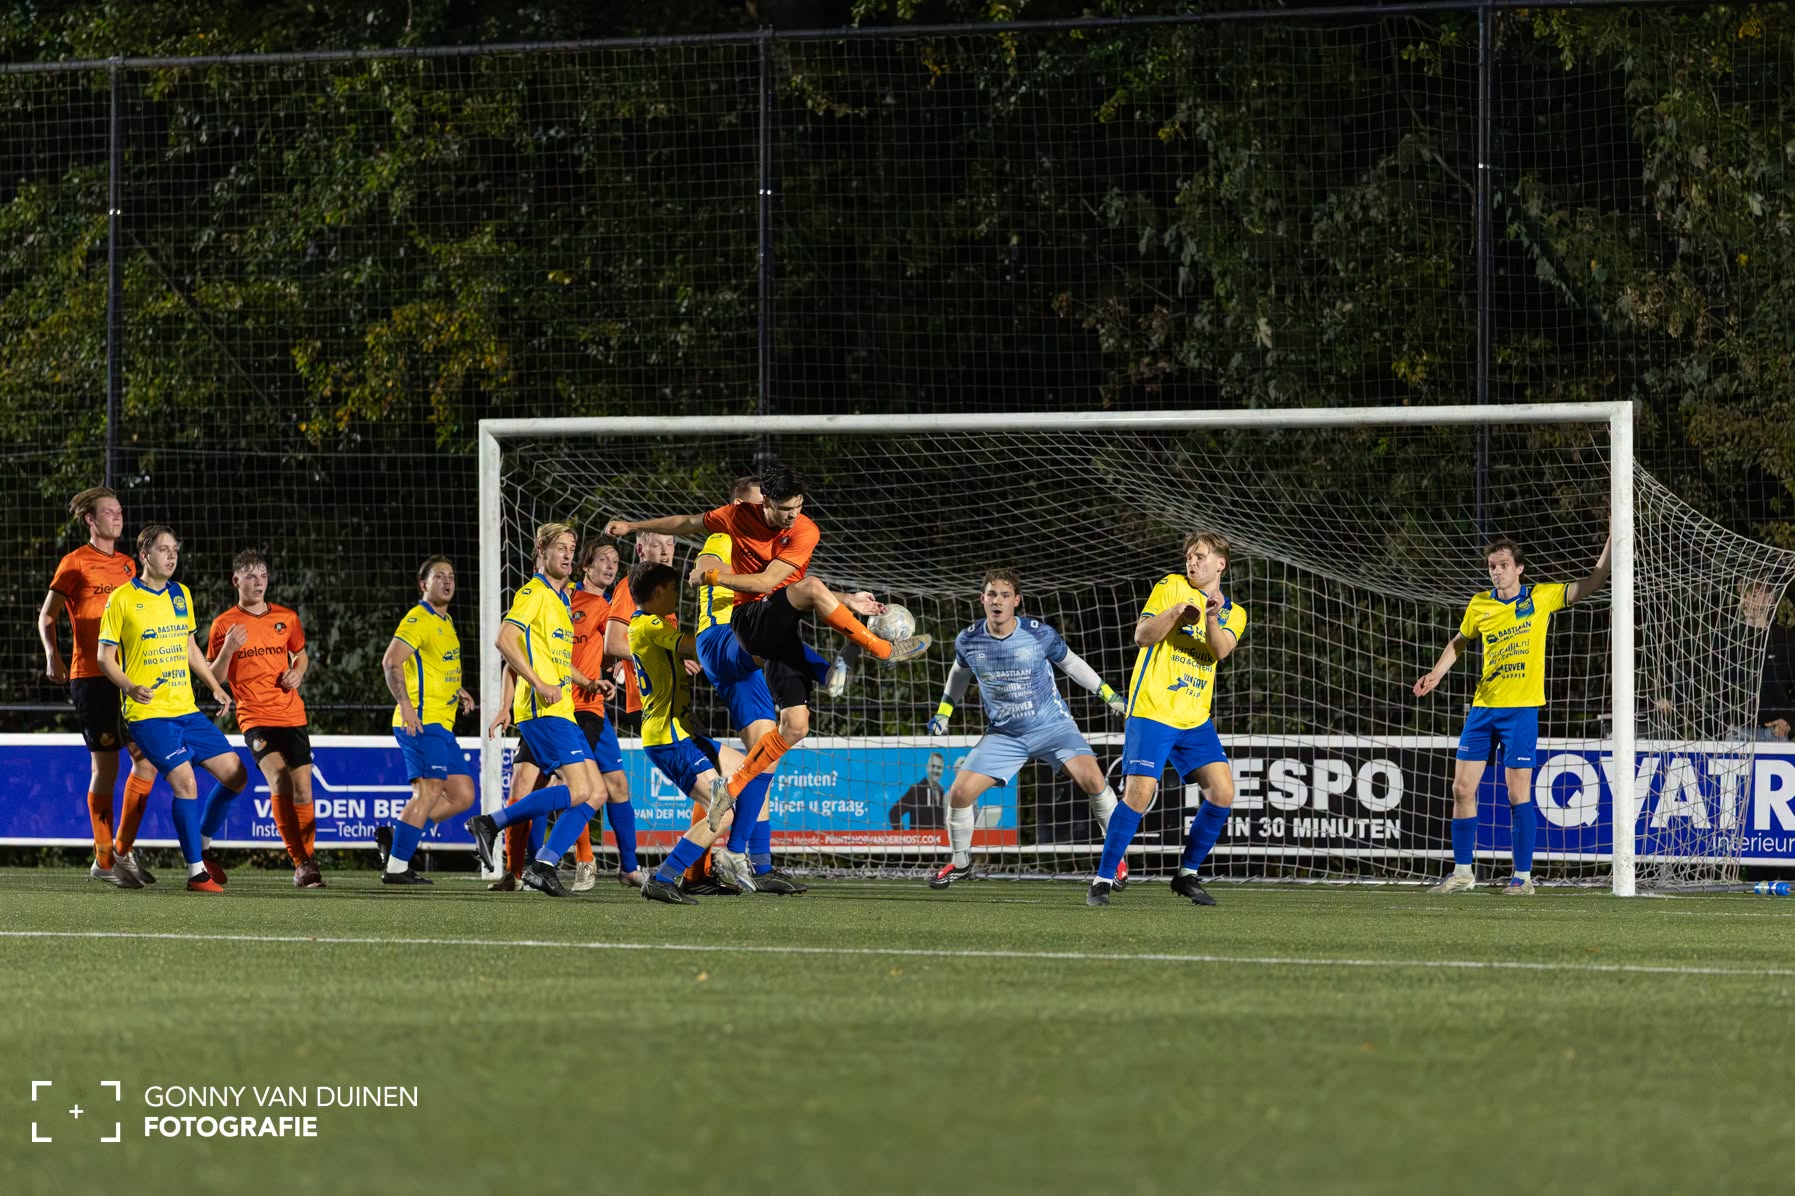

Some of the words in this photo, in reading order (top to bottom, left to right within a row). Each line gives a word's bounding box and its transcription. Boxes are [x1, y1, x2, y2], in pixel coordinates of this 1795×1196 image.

[94, 584, 118, 594] ziel
[238, 646, 285, 659] zielema
[996, 669, 1031, 677] BASTIAAN
[1505, 662, 1525, 672] ERVEN
[778, 770, 838, 791] printen?
[315, 799, 365, 818] DEN
[769, 796, 805, 816] elpen
[809, 801, 818, 812] u
[822, 801, 868, 816] graag.
[634, 809, 654, 819] VAN
[656, 809, 674, 819] DER
[677, 809, 692, 819] MO
[252, 821, 281, 837] Insta
[1227, 817, 1250, 836] IN
[1258, 817, 1284, 837] 30
[1293, 817, 1400, 839] MINUTEN
